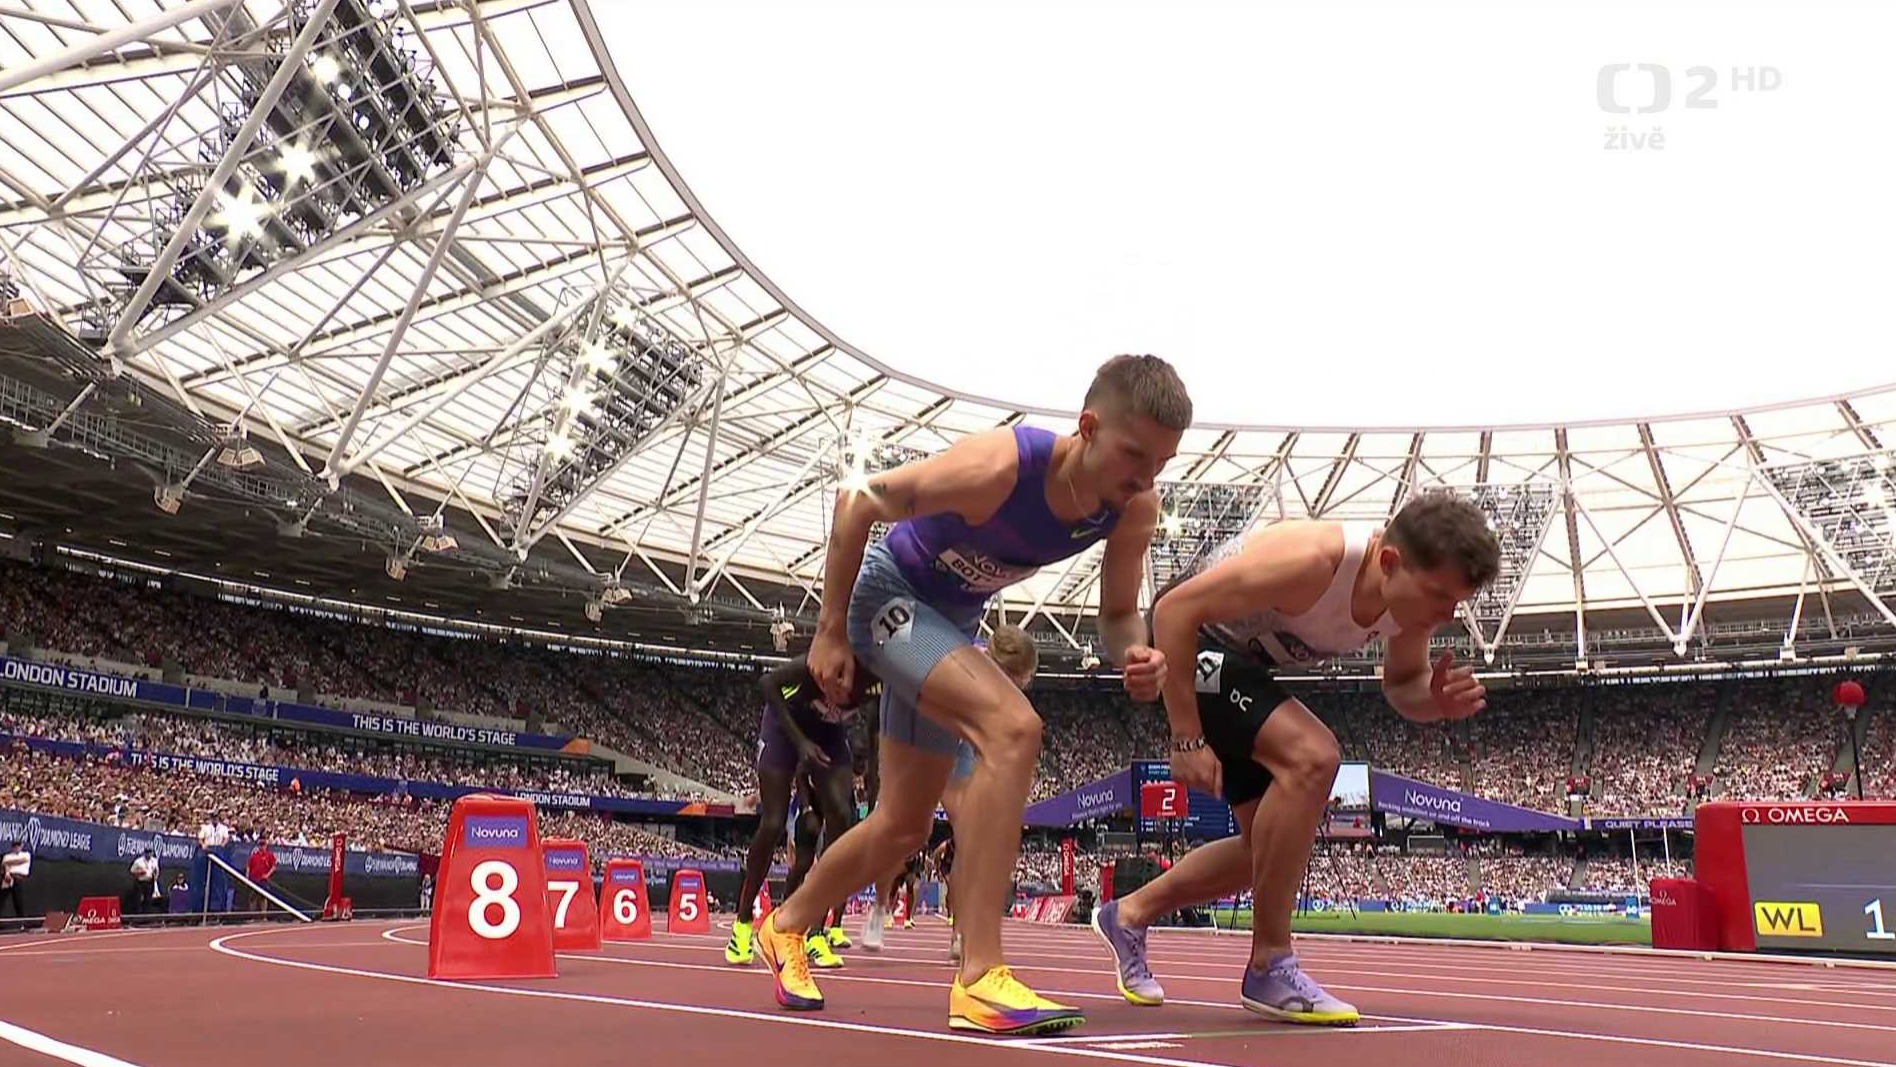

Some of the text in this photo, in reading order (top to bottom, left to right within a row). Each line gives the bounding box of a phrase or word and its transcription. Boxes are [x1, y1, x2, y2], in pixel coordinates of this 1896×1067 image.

[879, 605, 910, 640] 10
[67, 671, 138, 698] STADIUM
[352, 714, 517, 746] THIS IS THE WORLD'S STAGE
[158, 756, 169, 771] IS
[171, 757, 194, 772] THE
[195, 760, 243, 778] WORLD'S
[245, 766, 279, 781] STAGE
[552, 794, 591, 807] STADIUM
[1077, 788, 1114, 810] Novuna
[1162, 788, 1176, 811] 2
[1405, 788, 1461, 813] Novuna
[1605, 820, 1693, 830] QUIET PLEASE
[1768, 808, 1850, 823] OMEGA
[471, 826, 518, 839] Novuna
[468, 860, 521, 939] 8
[547, 880, 580, 929] 7
[613, 889, 638, 925] 6
[679, 893, 699, 922] 5
[1760, 898, 1896, 940] WL 1
